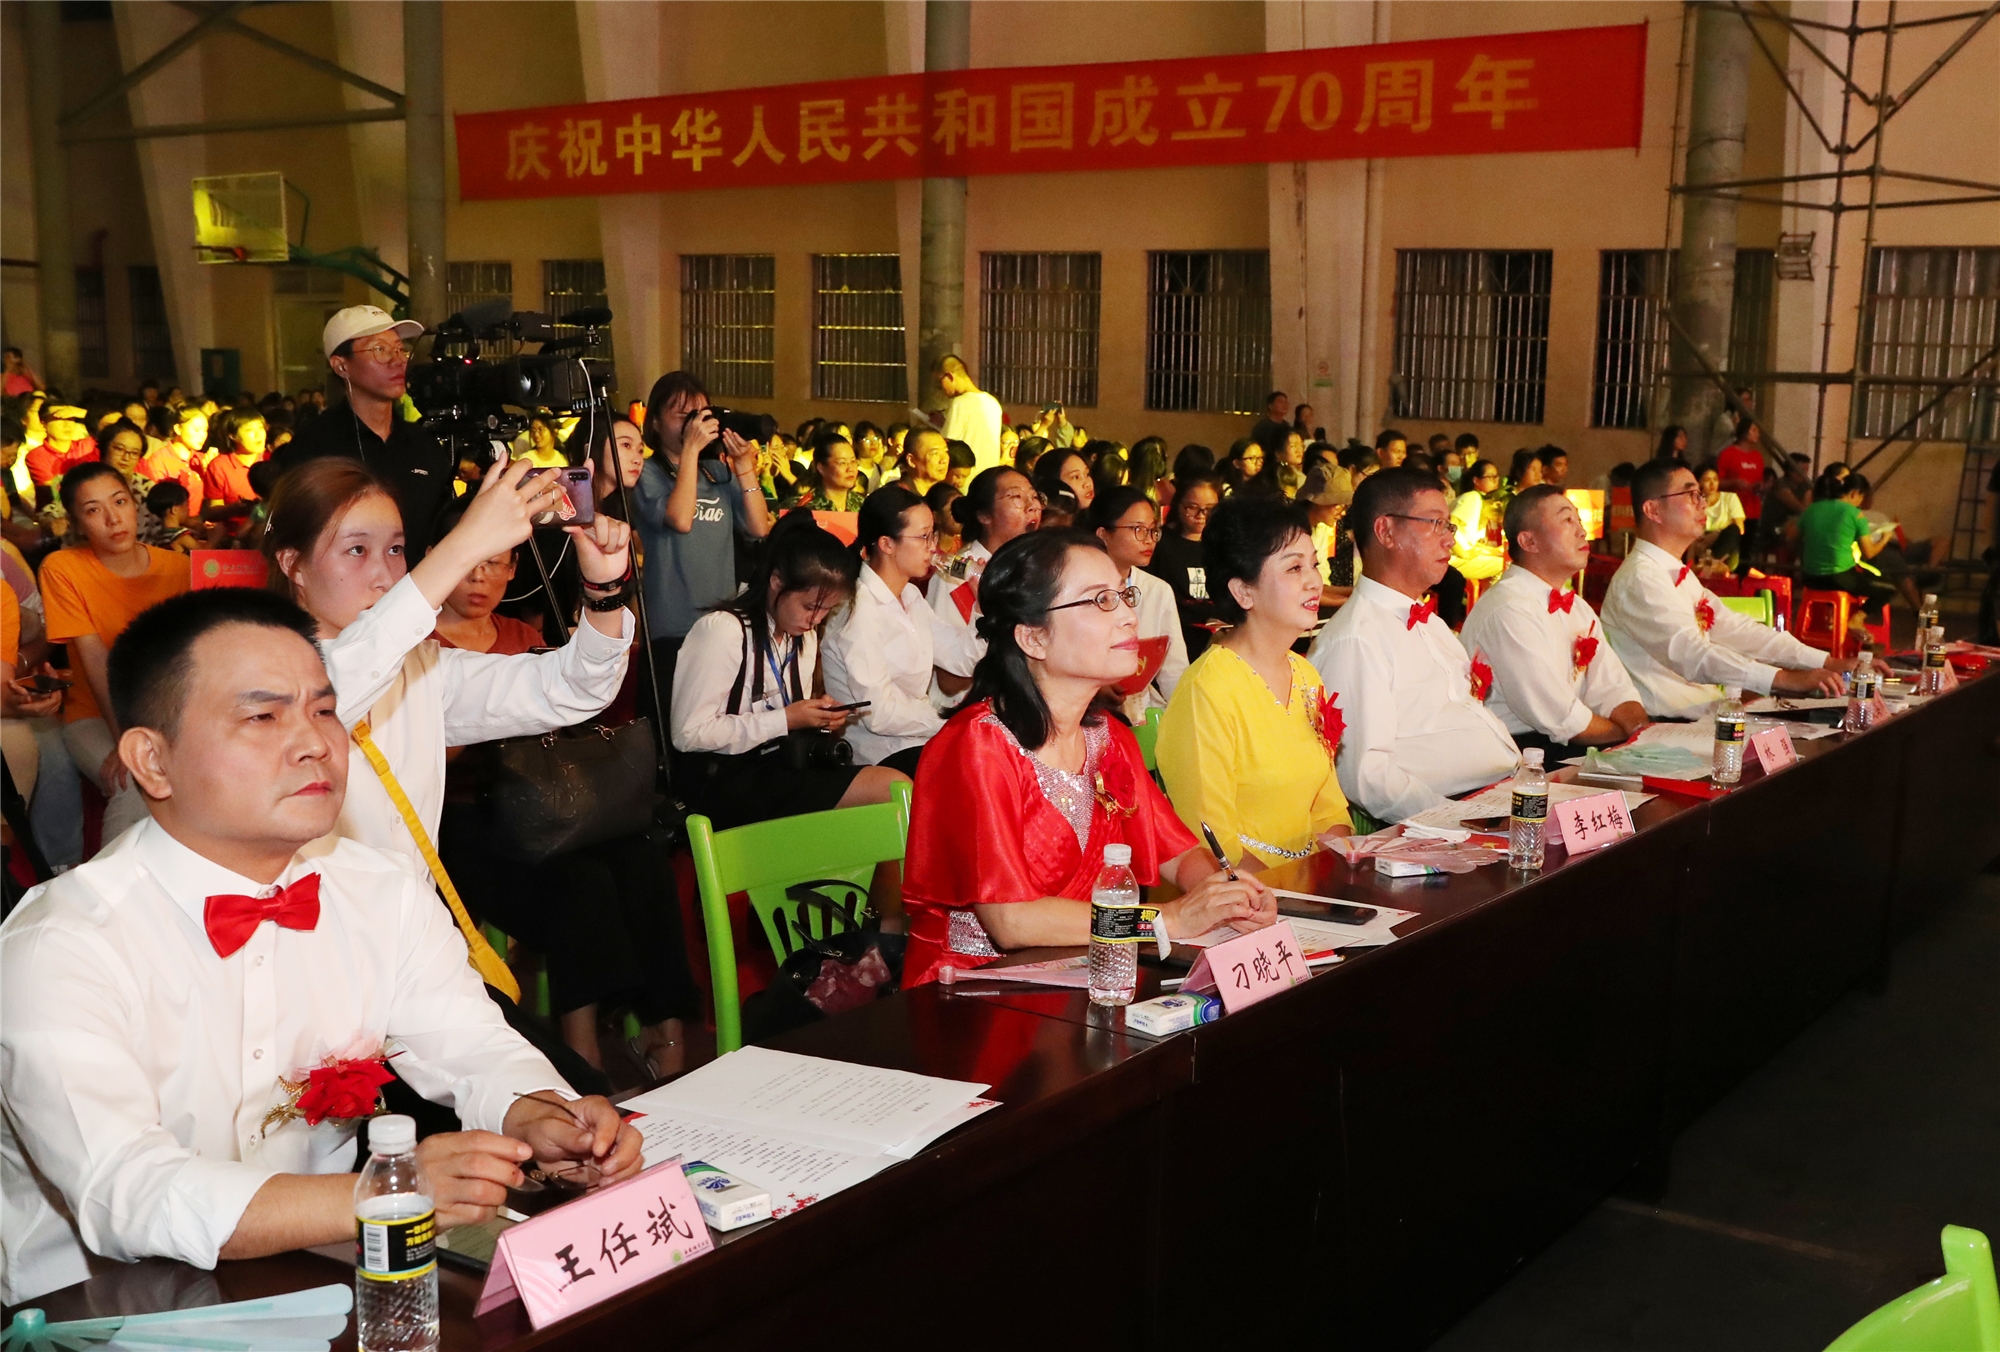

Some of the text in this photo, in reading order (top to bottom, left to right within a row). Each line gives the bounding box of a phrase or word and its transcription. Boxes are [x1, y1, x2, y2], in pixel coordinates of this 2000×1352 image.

[506, 54, 1539, 181] 庆祝中华人民共和国成立70周年
[1574, 805, 1623, 840] 李红梅
[1232, 940, 1294, 989] 刁晓平
[555, 1196, 694, 1292] 王任斌
